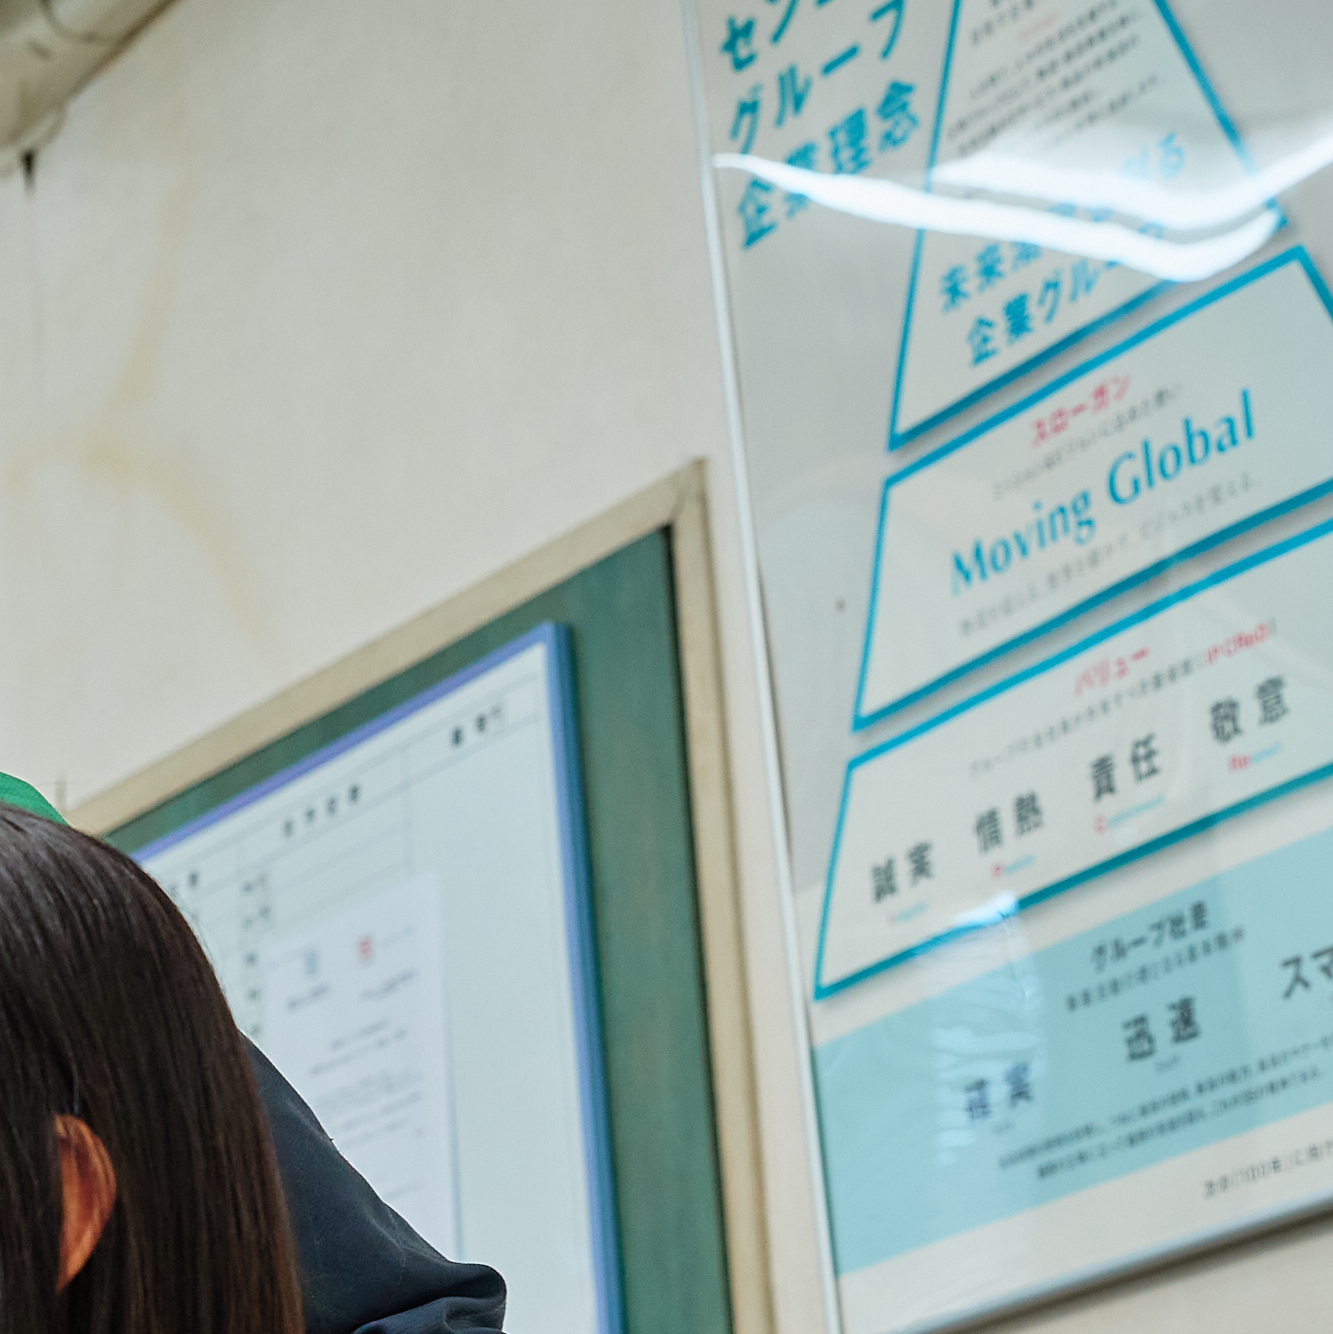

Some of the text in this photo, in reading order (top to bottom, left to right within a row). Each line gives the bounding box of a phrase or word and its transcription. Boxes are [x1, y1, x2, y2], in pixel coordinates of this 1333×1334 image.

[1031, 375, 1132, 448] スローガン
[950, 488, 1097, 598] Moving
[1105, 386, 1256, 507] Global
[870, 841, 934, 904] 誠実
[974, 790, 1044, 855] 情熱
[1089, 731, 1162, 803] 責任
[1208, 675, 1290, 745] 敬意
[1121, 995, 1202, 1064] 迅速
